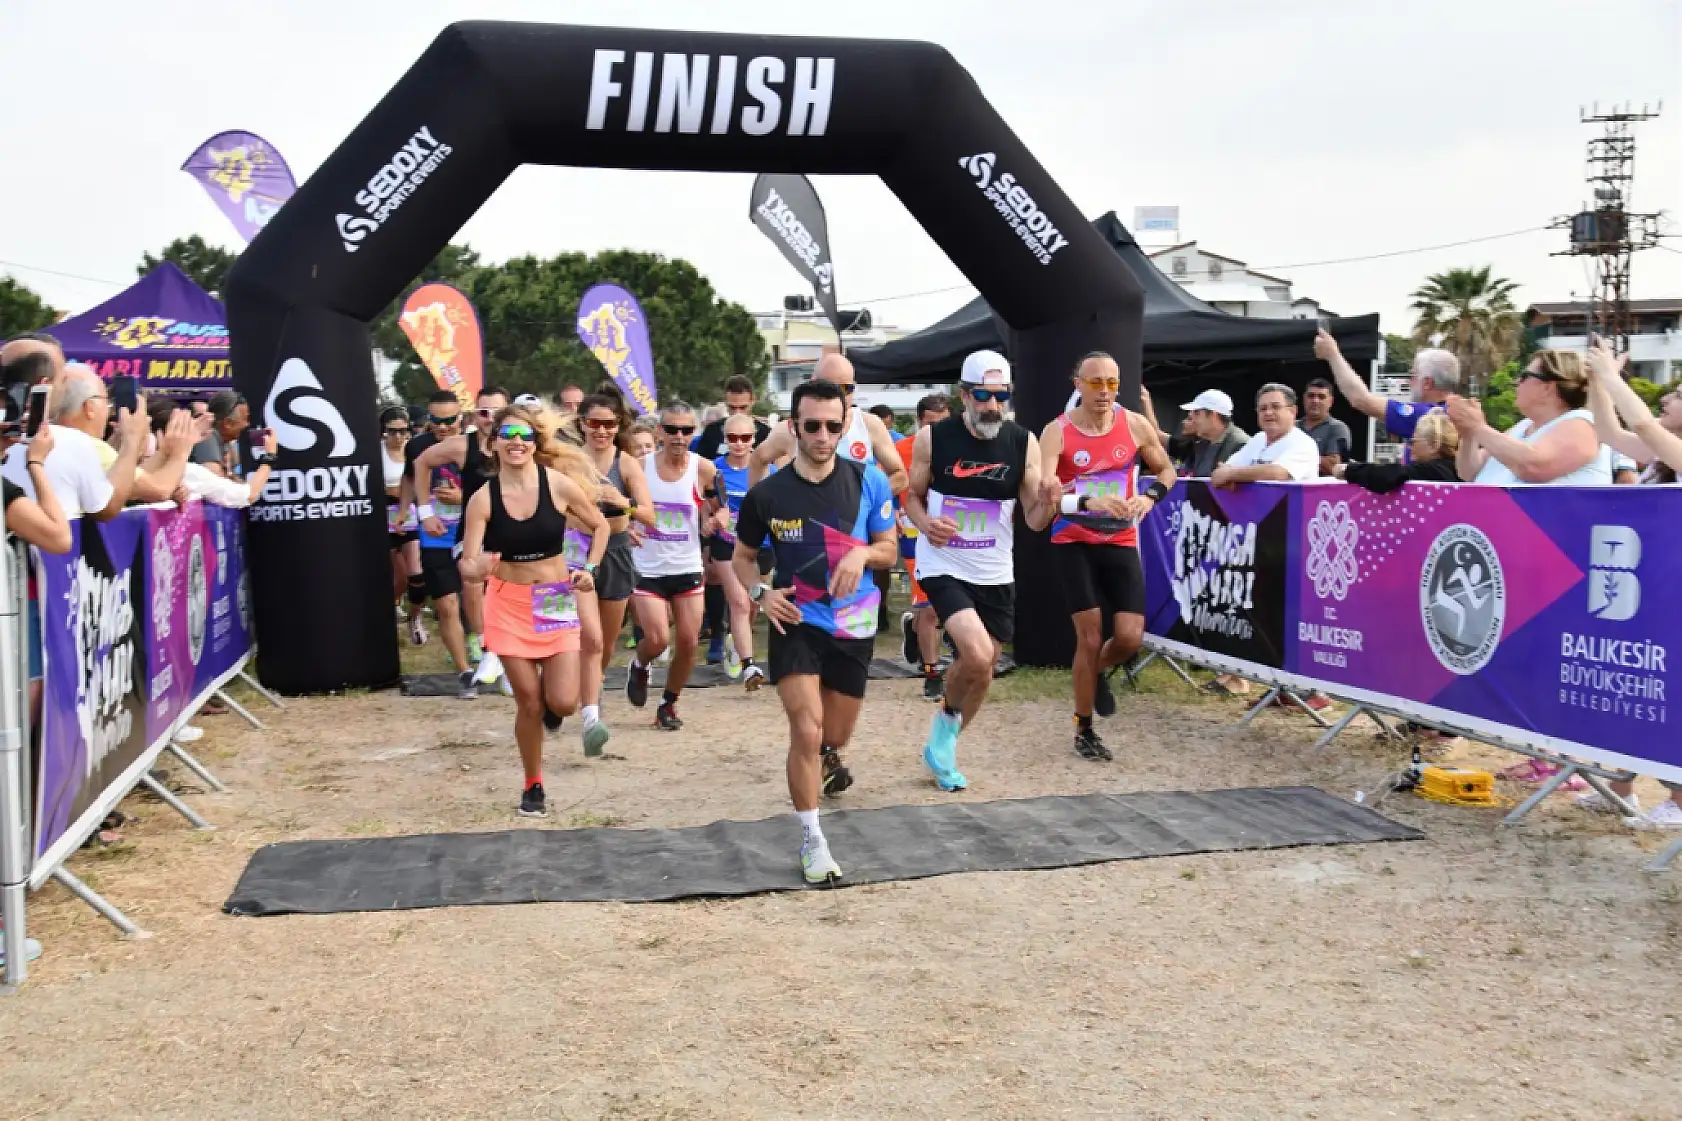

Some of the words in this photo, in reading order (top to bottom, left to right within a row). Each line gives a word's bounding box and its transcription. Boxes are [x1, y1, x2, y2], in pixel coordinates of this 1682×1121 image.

[585, 48, 836, 137] FINISH
[355, 125, 439, 214] SEDOXY
[991, 172, 1070, 253] SEDOXY
[147, 358, 232, 380] MARAT
[305, 498, 373, 519] EVENTS
[1561, 631, 1667, 673] BALIKESİR
[1560, 661, 1667, 702] BÜYÜKŞEHİR
[1559, 688, 1667, 724] BELEDİYESİ
